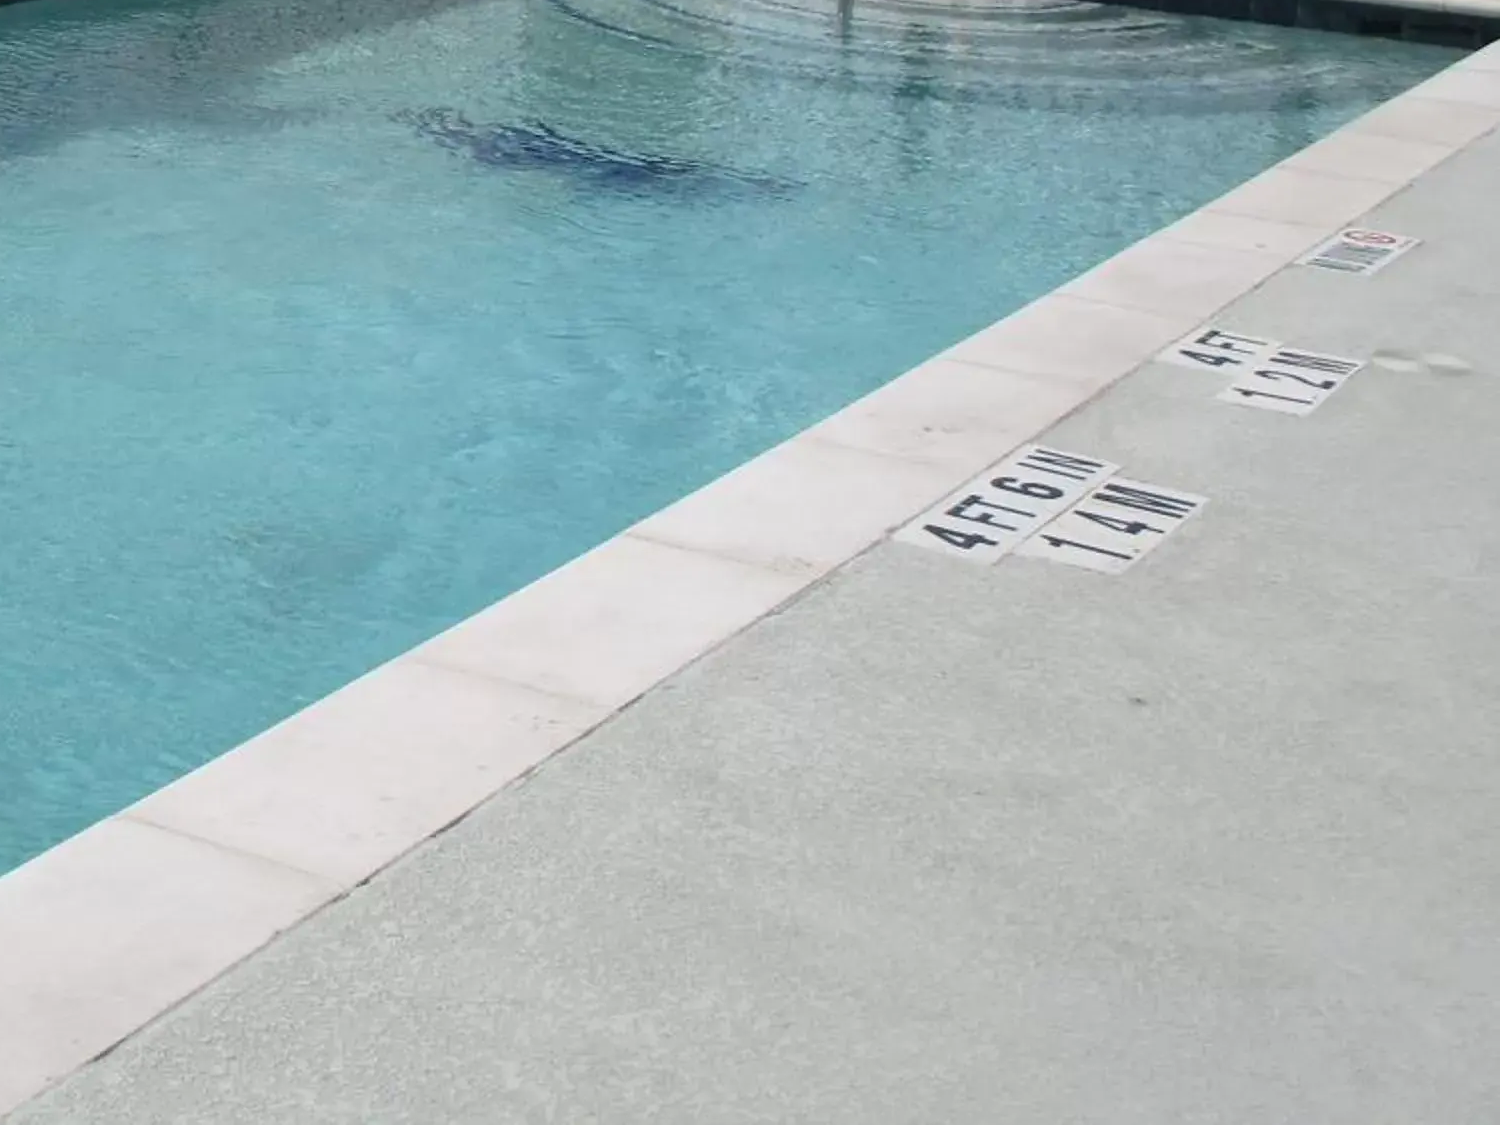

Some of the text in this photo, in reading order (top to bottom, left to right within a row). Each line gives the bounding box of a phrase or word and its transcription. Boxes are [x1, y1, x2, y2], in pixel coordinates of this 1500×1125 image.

[1267, 351, 1359, 375] M
[1016, 448, 1104, 481] IN
[1091, 482, 1198, 520] M
